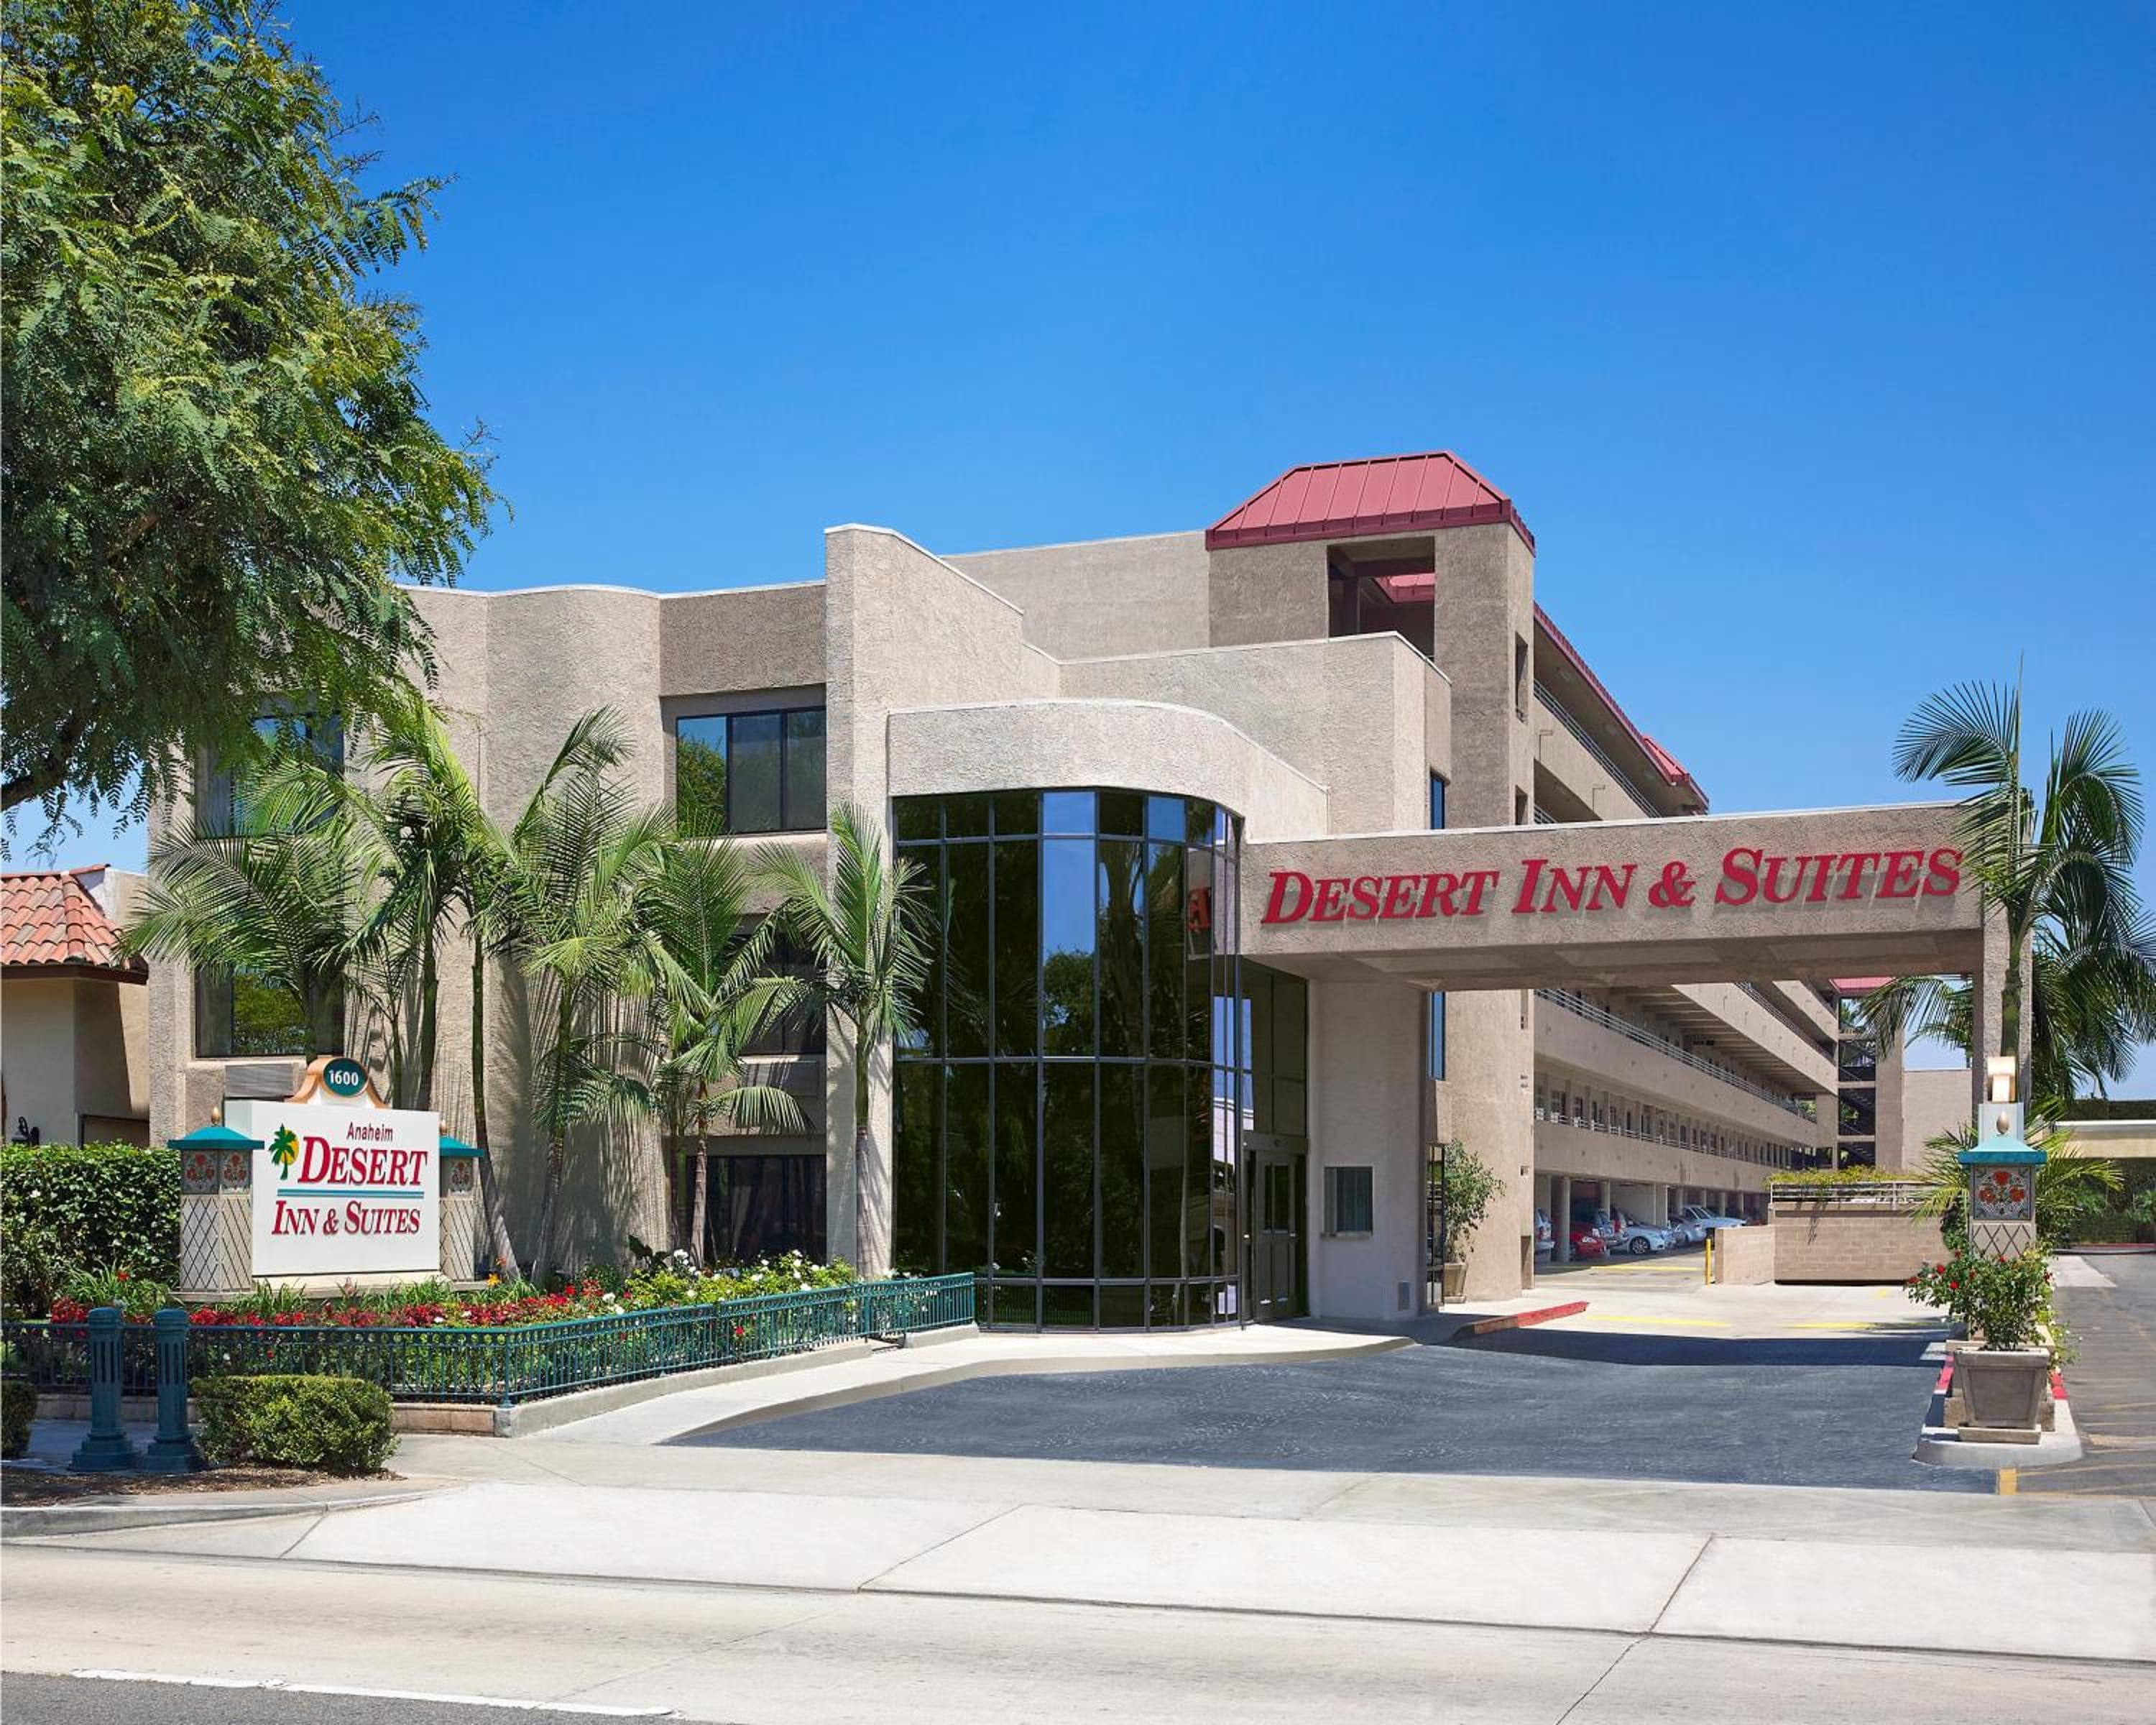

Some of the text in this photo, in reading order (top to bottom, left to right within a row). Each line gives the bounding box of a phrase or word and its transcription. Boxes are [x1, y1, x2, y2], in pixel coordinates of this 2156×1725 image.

[1261, 870, 1500, 924] DESERT
[1511, 858, 1638, 914] INN
[1648, 861, 1696, 908] &
[1715, 847, 1963, 907] SUITES
[328, 1069, 359, 1086] 1600
[346, 1121, 393, 1142] Anaheim
[298, 1136, 428, 1186] DESERT
[271, 1200, 421, 1236] INN & SUITES
